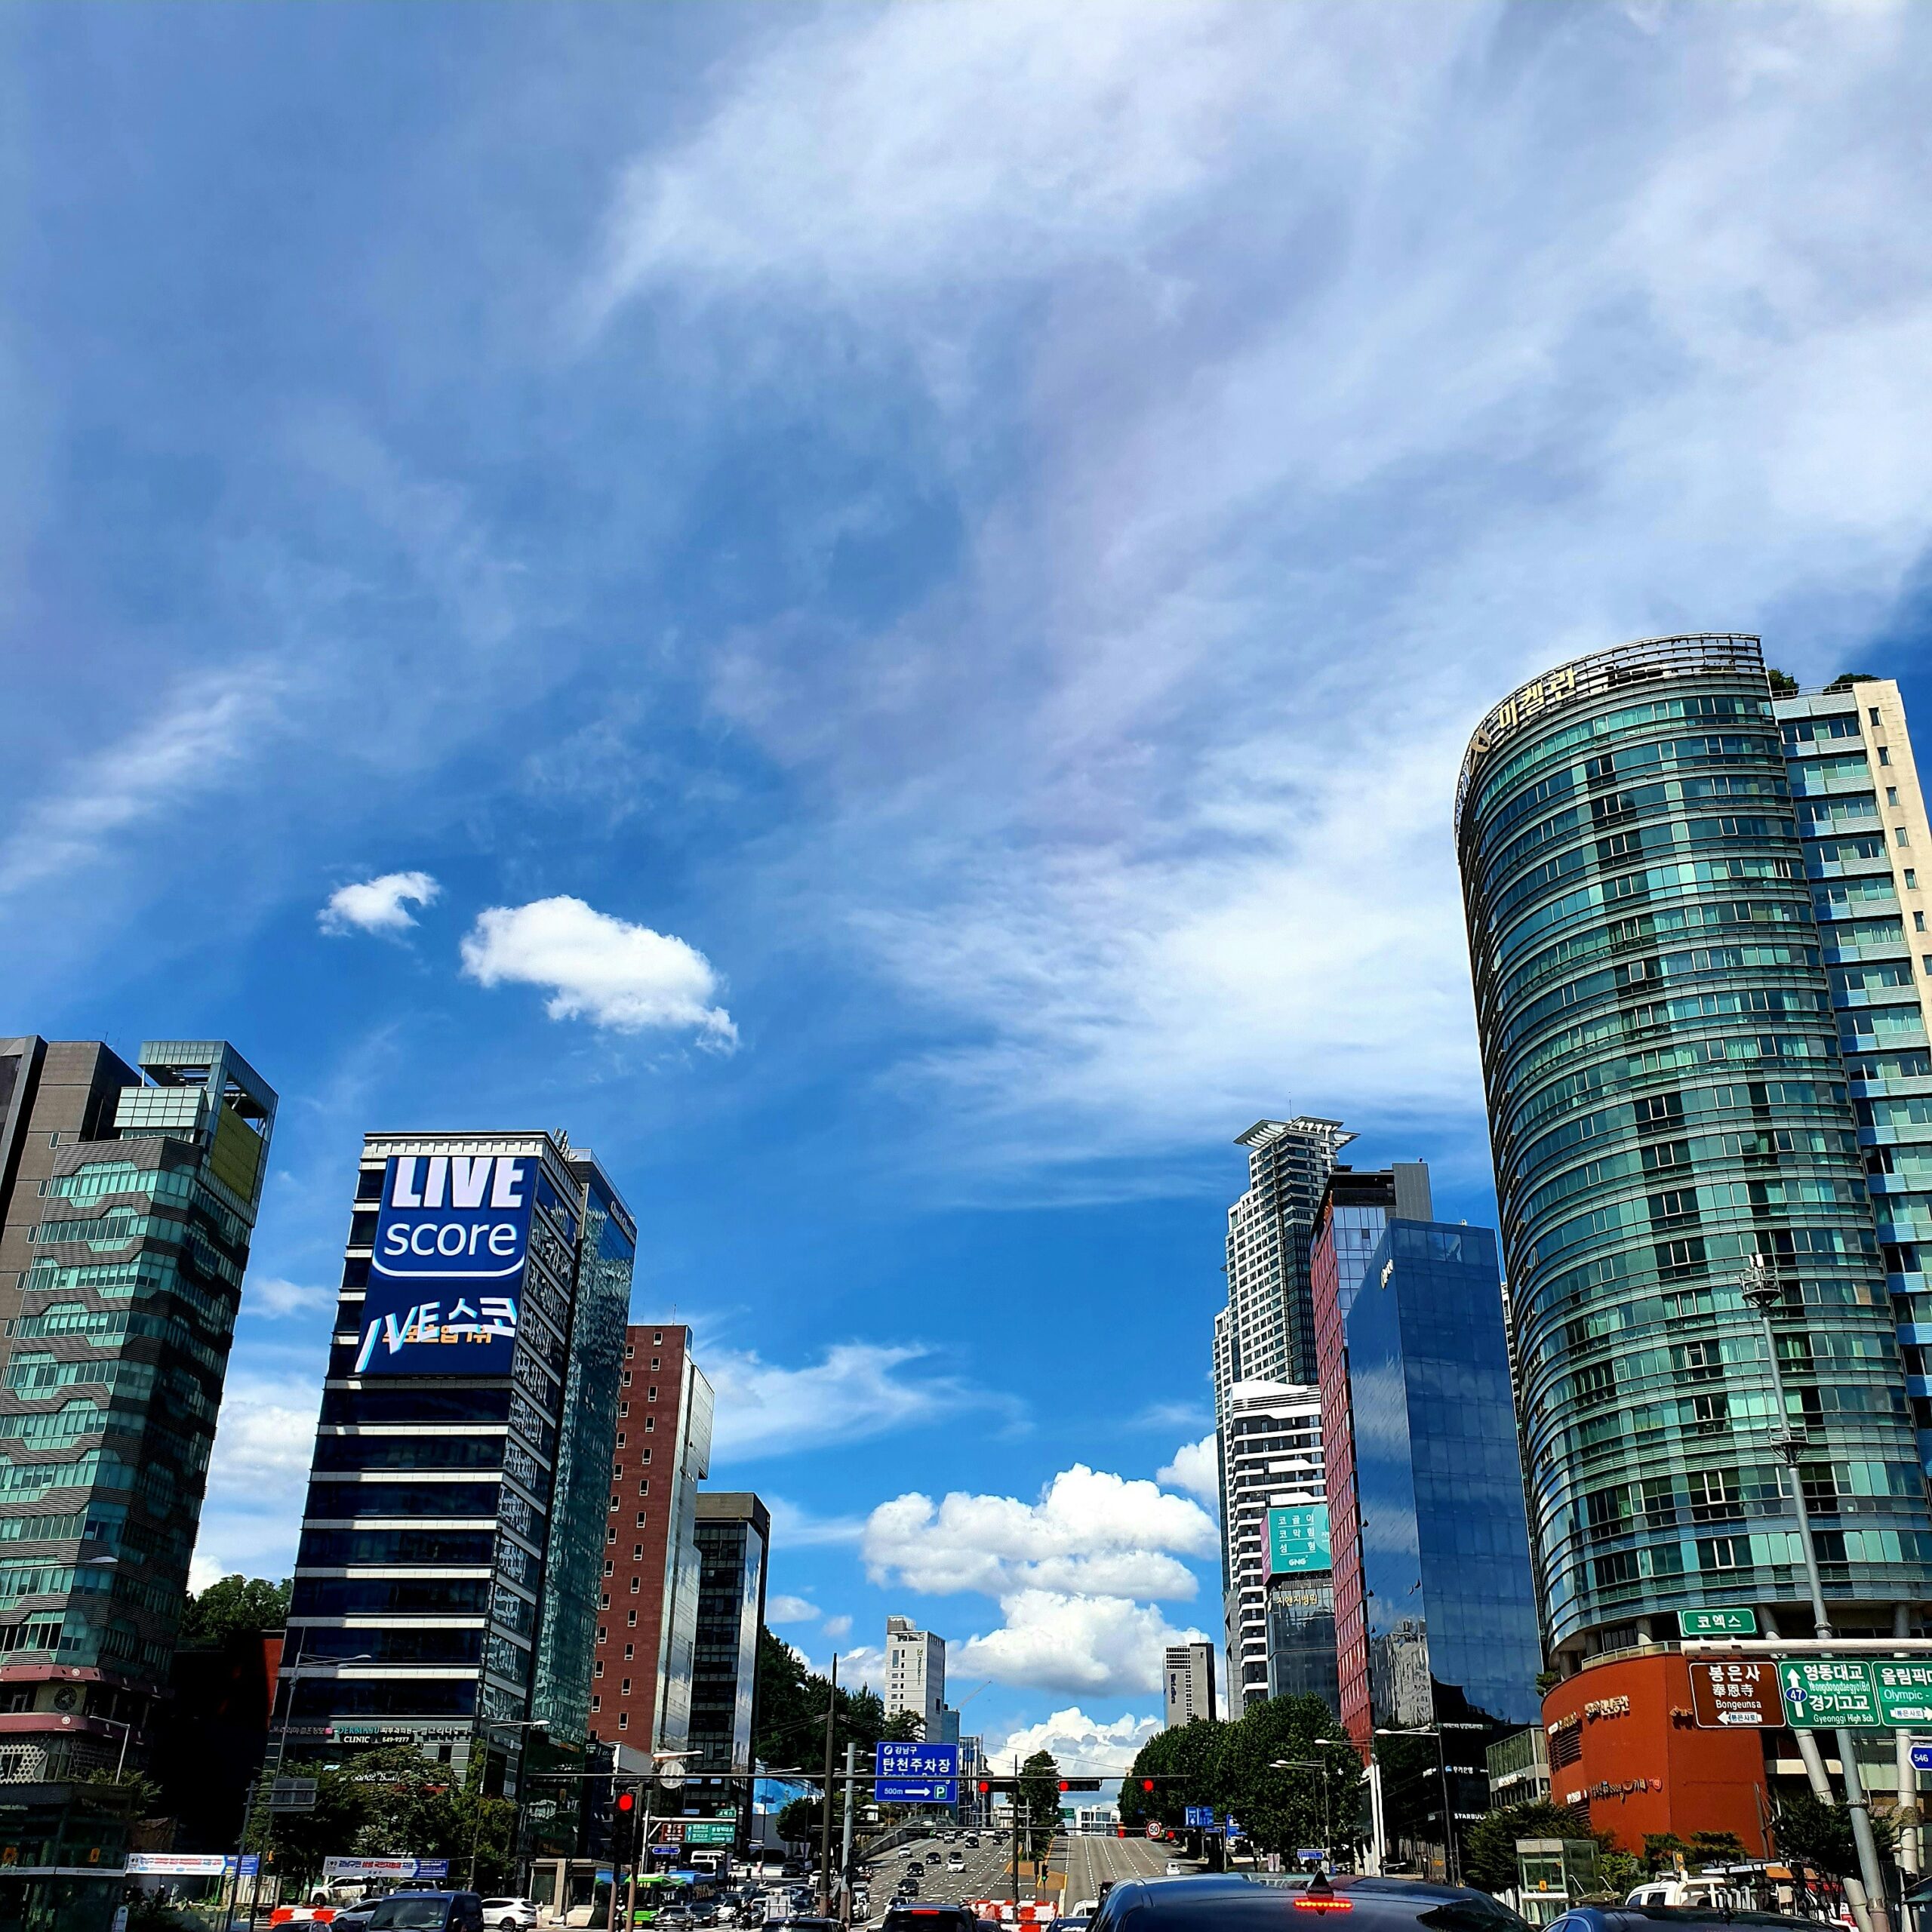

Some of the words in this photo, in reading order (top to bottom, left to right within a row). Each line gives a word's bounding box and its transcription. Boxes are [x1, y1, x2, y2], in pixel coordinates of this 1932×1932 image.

[1499, 665, 1577, 729] 미켈란
[391, 1157, 525, 1208] LIVE
[383, 1223, 517, 1256] score
[1276, 1594, 1318, 1607] 지앤지병원
[1697, 1614, 1742, 1629] 코엑스
[1709, 1665, 1761, 1682] 봉은사
[1804, 1664, 1864, 1681] 영동대교
[1712, 1684, 1754, 1697] 奉恩寺
[1790, 1689, 1802, 1701] 47
[1715, 1700, 1762, 1710] Bongeunsa
[1809, 1694, 1870, 1712] 경기고교
[1814, 1714, 1846, 1724] Gyeonggi
[1847, 1714, 1862, 1724] High
[1863, 1714, 1874, 1722] Sch
[895, 1746, 917, 1755] 강남구
[1914, 1754, 1929, 1762] 546
[882, 1758, 951, 1773] 탄천주차장
[1149, 1825, 1158, 1833] 50
